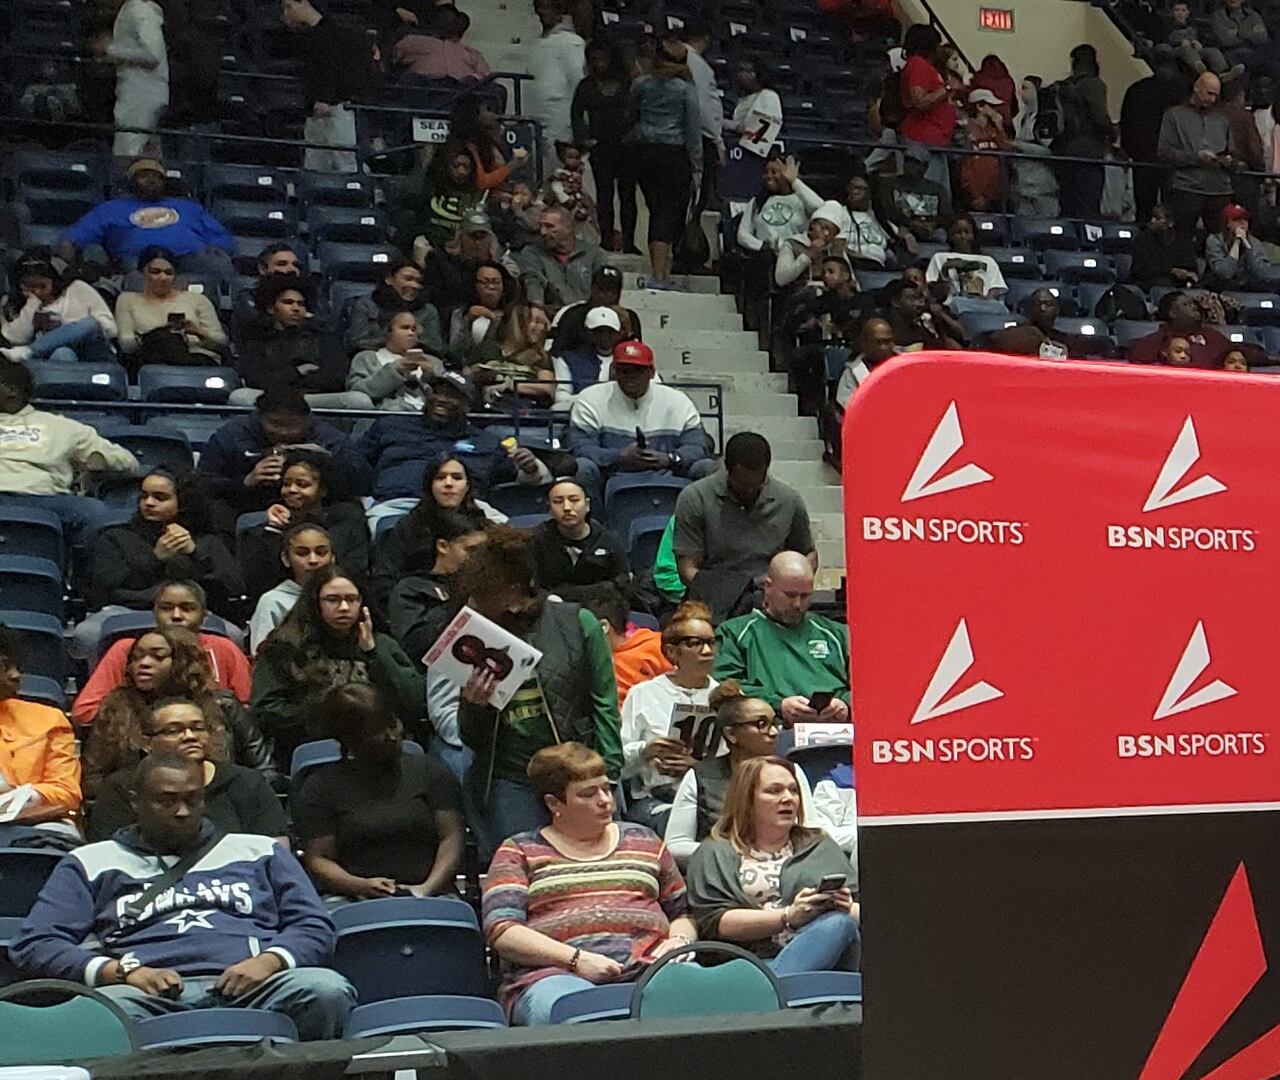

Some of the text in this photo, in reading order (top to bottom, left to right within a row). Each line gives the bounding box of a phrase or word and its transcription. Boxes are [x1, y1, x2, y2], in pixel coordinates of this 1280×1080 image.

[981, 9, 1011, 29] EXIT
[660, 315, 669, 328] F
[682, 351, 691, 365] E
